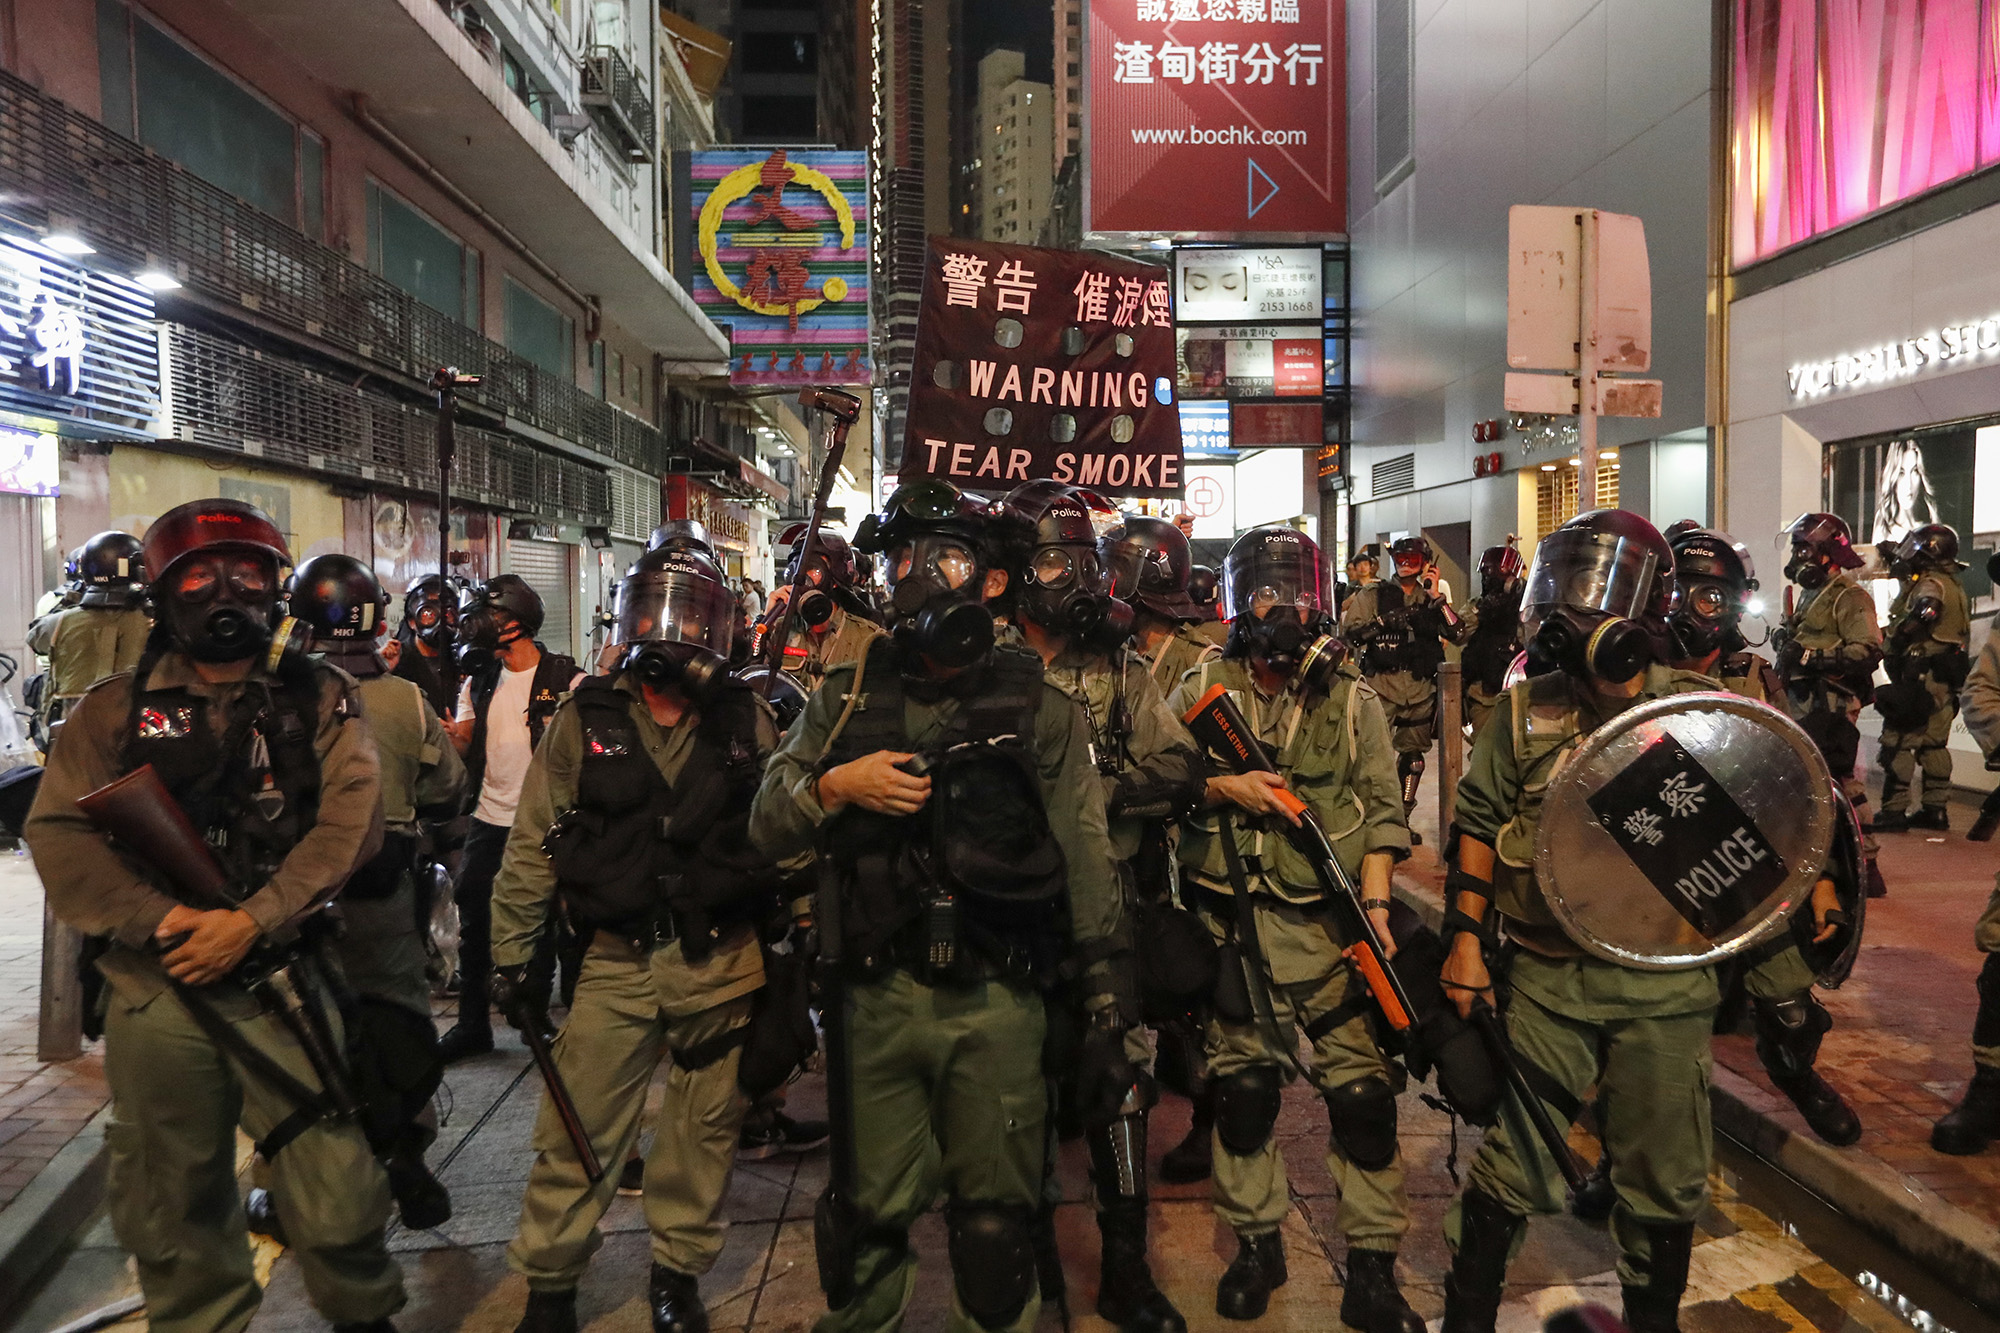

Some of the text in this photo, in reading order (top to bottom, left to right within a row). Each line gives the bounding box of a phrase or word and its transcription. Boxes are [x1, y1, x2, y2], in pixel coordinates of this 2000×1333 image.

[1113, 41, 1324, 86] 渣甸街分行
[1131, 125, 1307, 146] www.bochk.com
[942, 253, 1037, 315] 警告
[1260, 301, 1313, 312] 2153 1668
[1939, 319, 2000, 361] SEC
[970, 359, 1147, 408] WARNING
[1239, 387, 1263, 397] 20/F
[924, 439, 1179, 489] TEAR SMOKE
[196, 513, 242, 524] Police
[1051, 507, 1082, 518] Police
[1265, 534, 1300, 545] Police
[1683, 548, 1715, 558] Police
[333, 628, 355, 637] HKI
[1212, 708, 1249, 761] LESS LETHAL
[1623, 771, 1707, 847] 警察
[1674, 826, 1767, 911] POLICE
